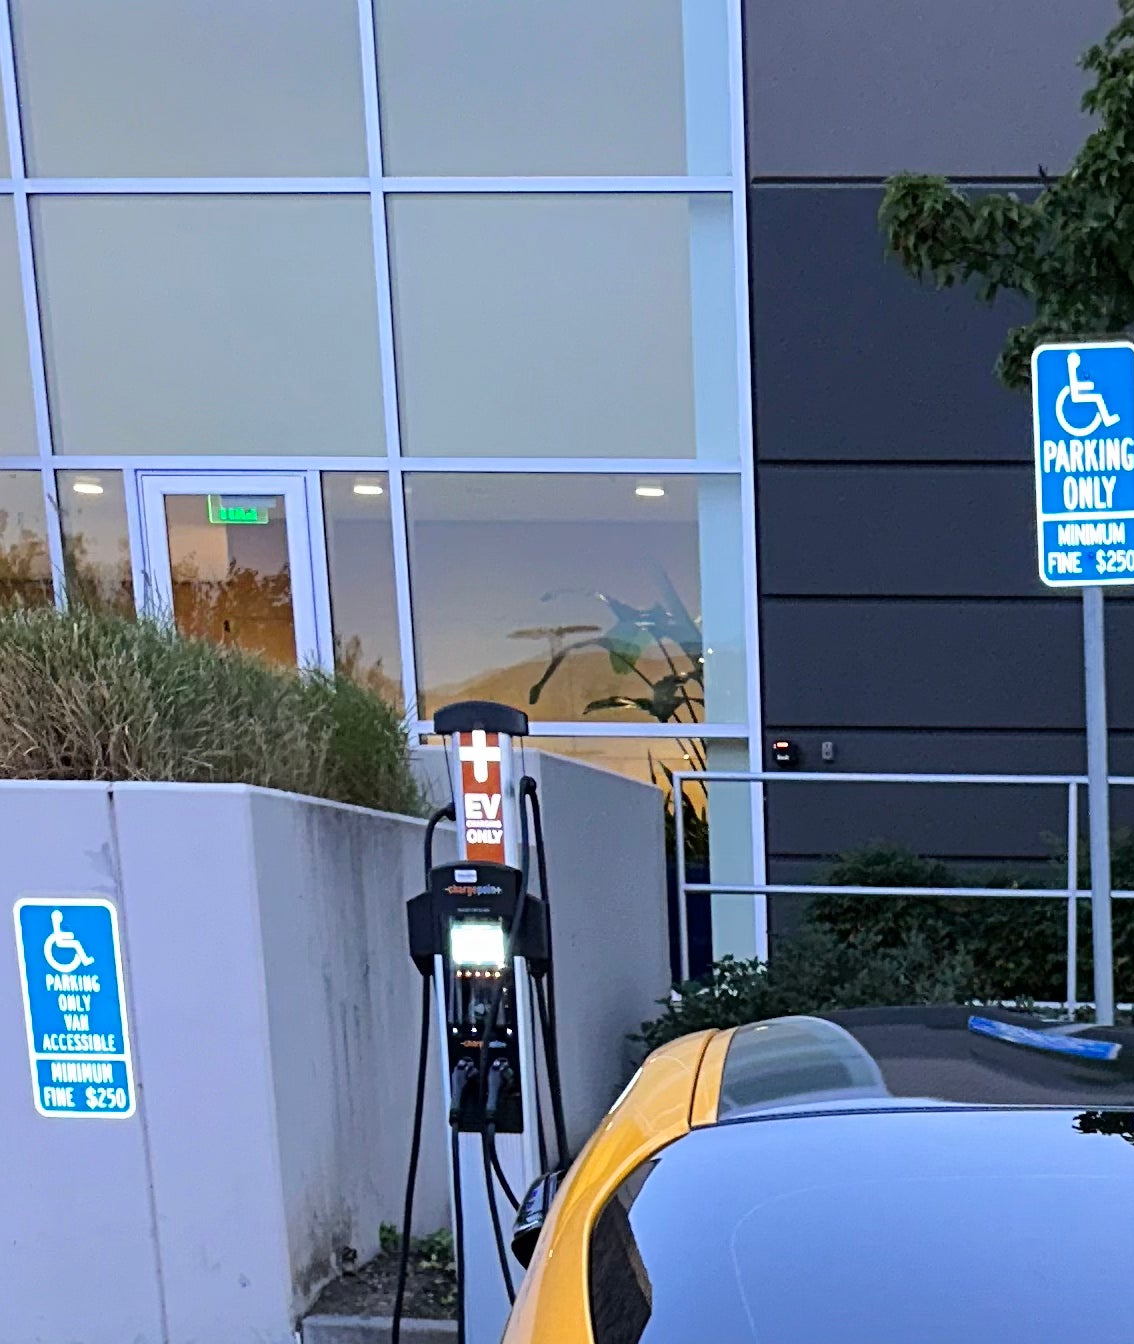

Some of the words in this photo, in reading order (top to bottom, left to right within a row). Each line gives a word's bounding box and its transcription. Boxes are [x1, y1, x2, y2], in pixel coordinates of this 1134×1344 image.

[1043, 437, 1134, 474] PARKING
[1063, 476, 1117, 510] ONLY
[1057, 522, 1126, 546] MINIMUM
[1048, 552, 1082, 574] FINE
[464, 793, 501, 820] EV
[466, 828, 503, 844] ONLY
[45, 974, 100, 992] PARKING
[58, 994, 91, 1011] ONLY
[64, 1014, 90, 1031] VAN
[43, 1034, 116, 1052] ACCESSIBLE
[51, 1062, 114, 1083] MINIMUM
[43, 1086, 76, 1107] FINE
[85, 1086, 127, 1109] $250
